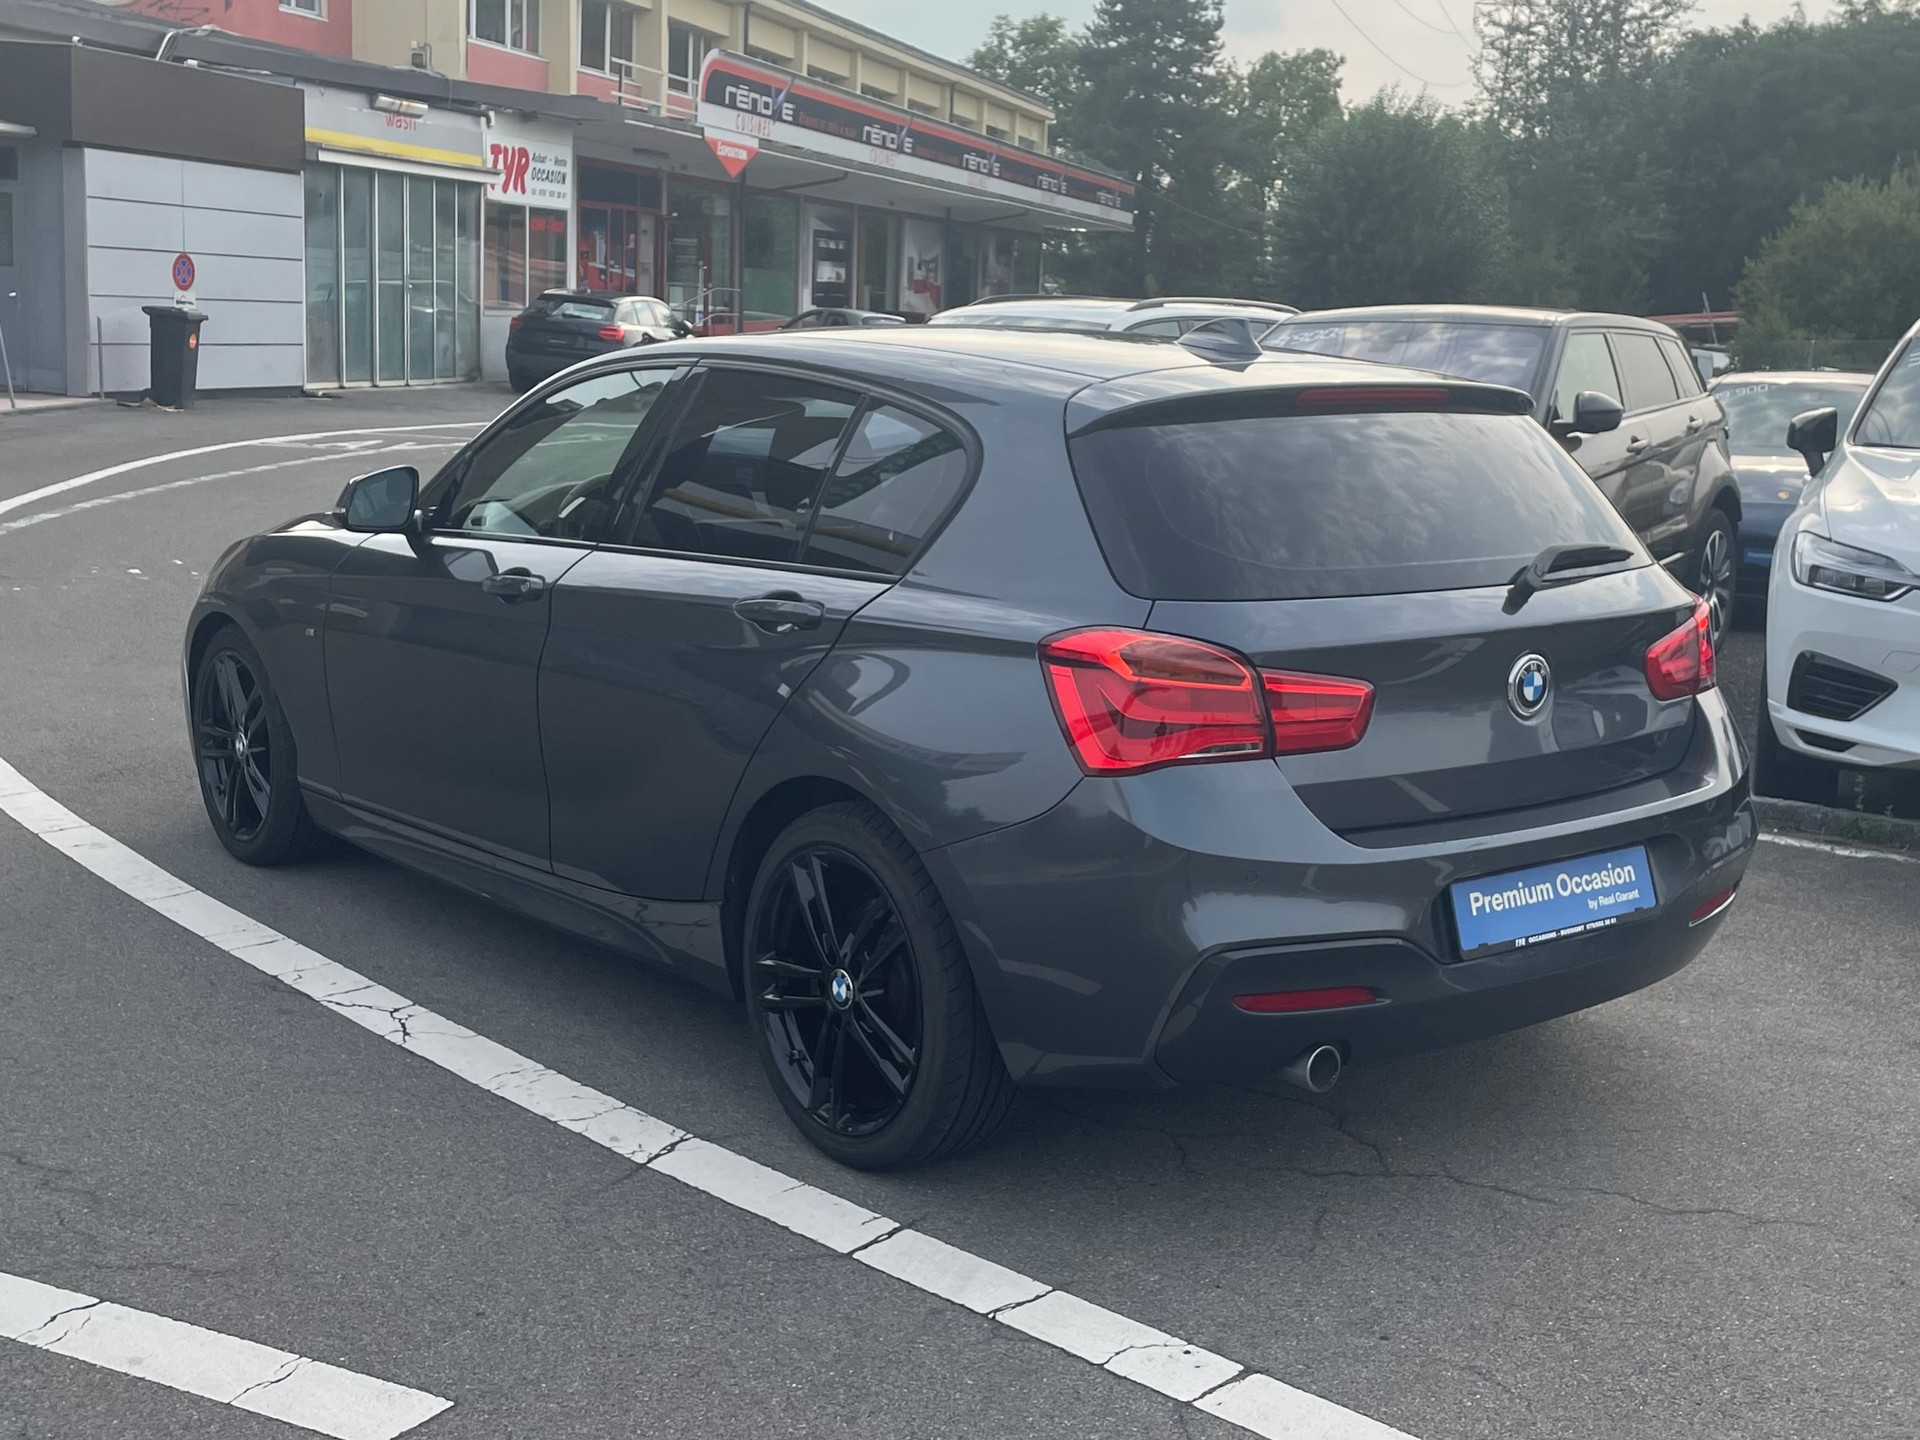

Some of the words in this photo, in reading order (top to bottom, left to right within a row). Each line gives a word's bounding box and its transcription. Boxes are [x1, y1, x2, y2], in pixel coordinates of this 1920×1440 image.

[490, 143, 530, 195] TYR
[531, 166, 567, 185] OCCASION
[1469, 881, 1554, 916] Premium
[1556, 863, 1636, 897] Occasion
[1587, 898, 1598, 910] by
[1598, 893, 1615, 906] Real
[1615, 888, 1640, 902] Garant
